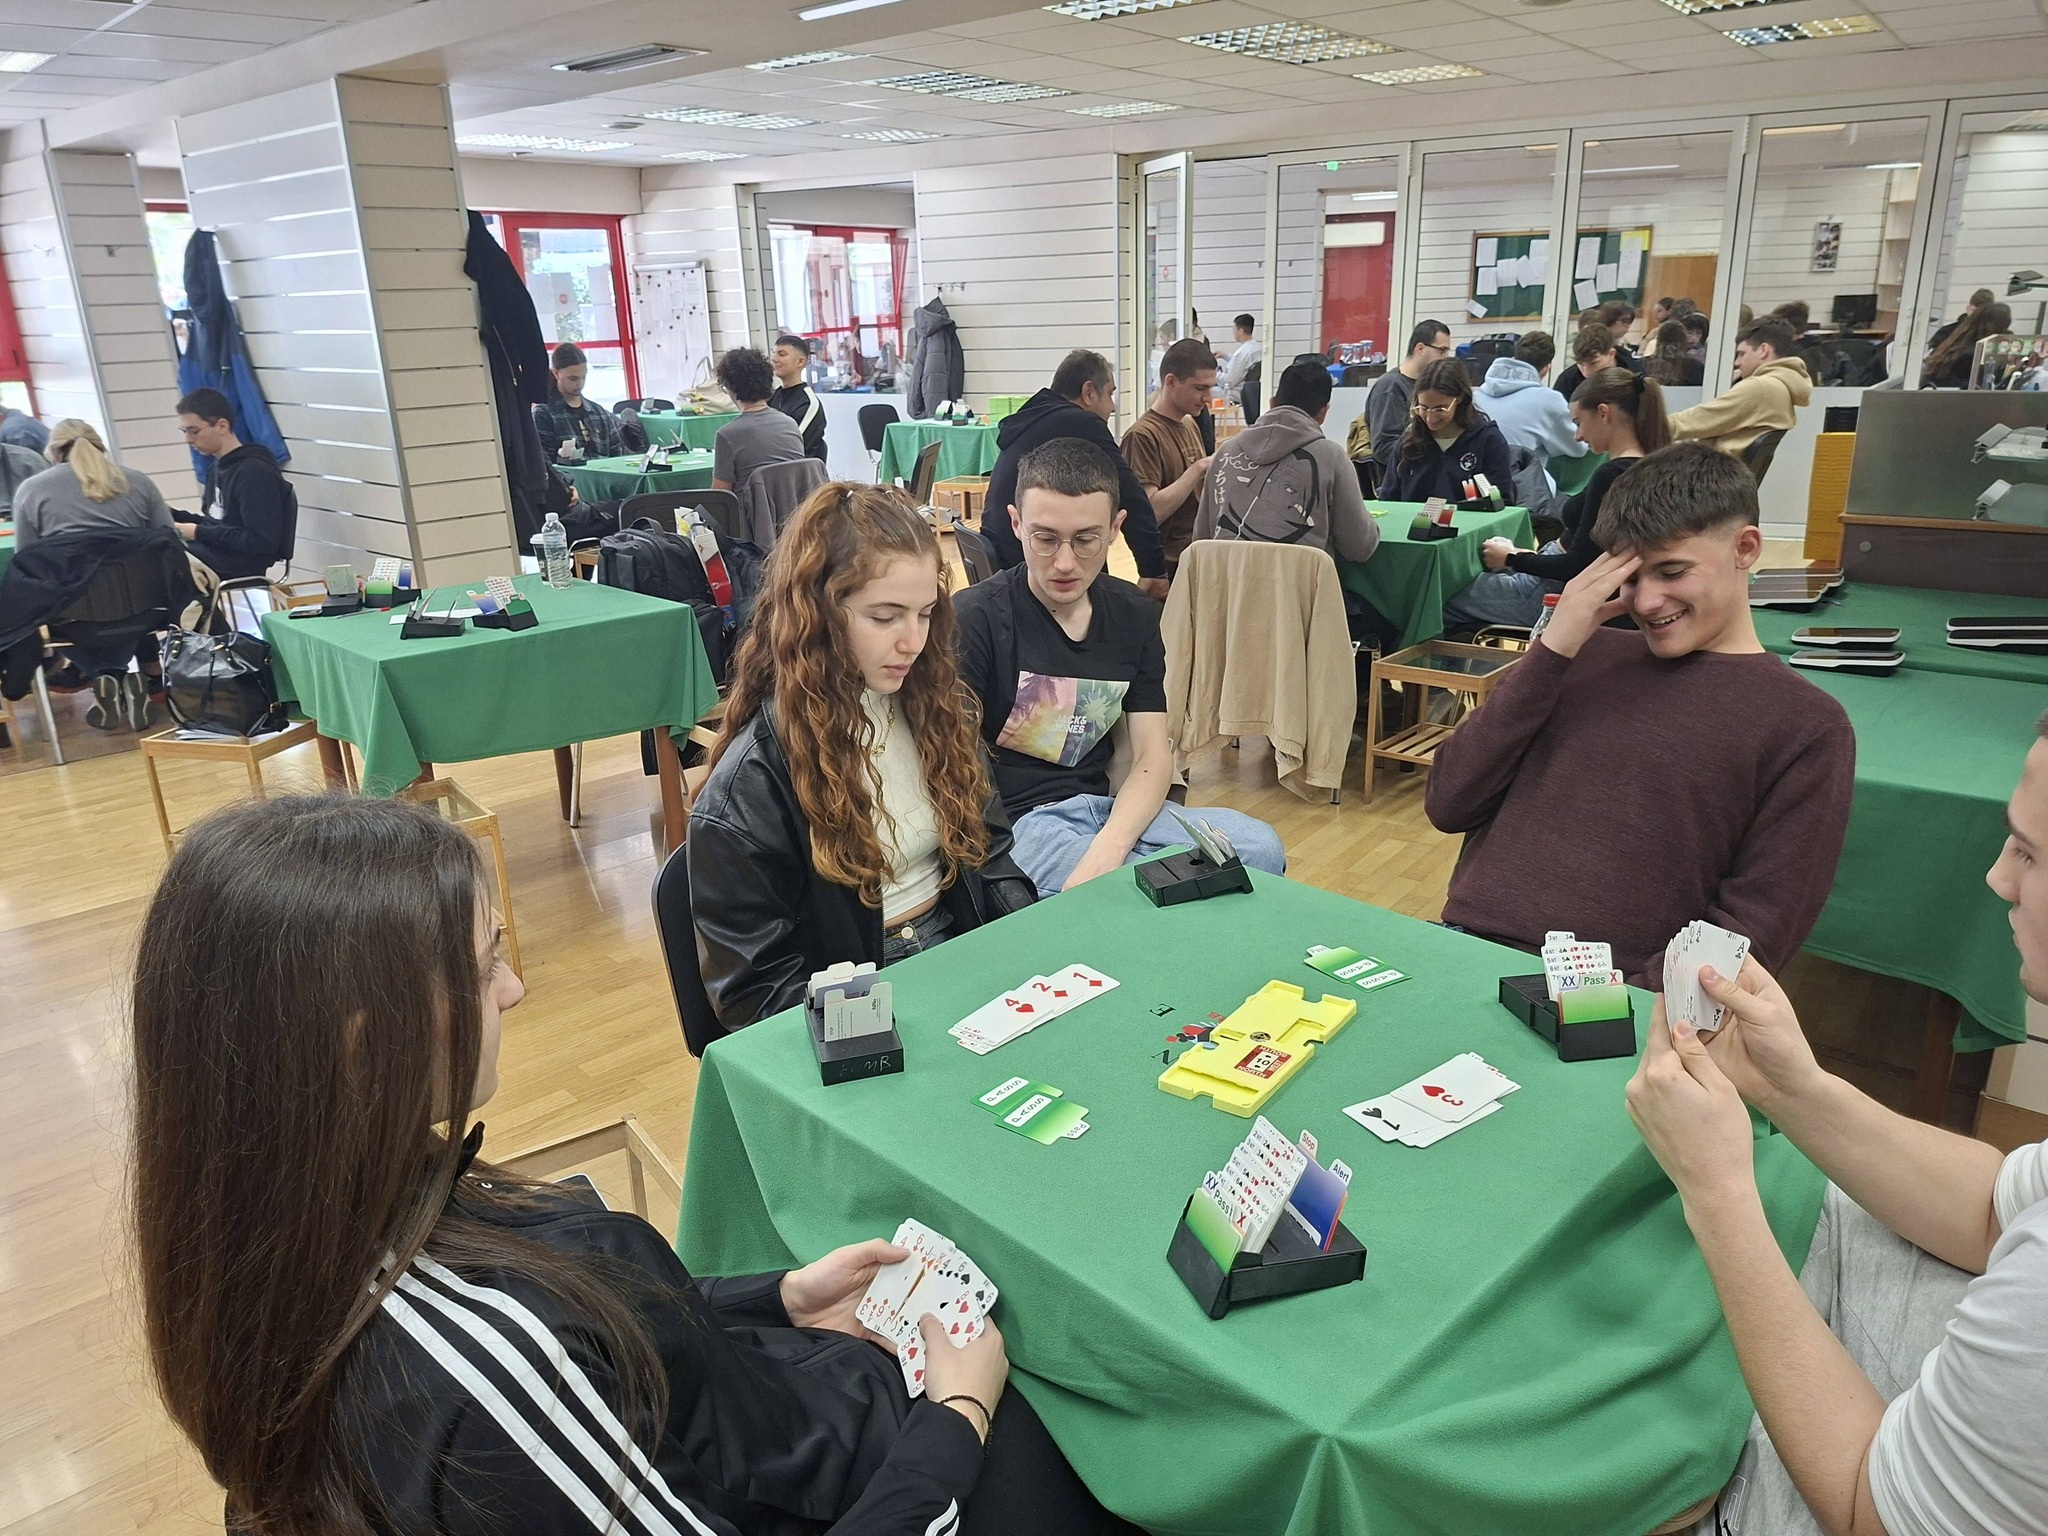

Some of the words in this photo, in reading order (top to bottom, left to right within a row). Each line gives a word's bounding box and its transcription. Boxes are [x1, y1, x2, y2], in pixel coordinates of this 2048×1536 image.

[1052, 724, 1085, 734] JONES
[1737, 941, 1745, 953] A
[1073, 972, 1088, 980] 1
[1561, 976, 1576, 987] XX
[1584, 977, 1606, 986] Pass
[1610, 972, 1618, 983] X
[1032, 982, 1052, 993] 2
[1005, 998, 1020, 1007] 4
[1149, 1003, 1176, 1018] E
[1259, 1046, 1288, 1058] SOUTH
[1257, 1058, 1271, 1066] 10
[1238, 1066, 1267, 1078] NORTH
[987, 1079, 1022, 1103] PASS
[1441, 1095, 1464, 1107] 3
[1012, 1097, 1045, 1123] PASS
[1382, 1119, 1401, 1131] 1
[1302, 1132, 1316, 1150] Stop
[1332, 1163, 1350, 1183] Alert
[1205, 1175, 1219, 1191] XX
[1213, 1191, 1230, 1215] Pass
[1236, 1212, 1247, 1228] X
[916, 1233, 925, 1245] 6
[958, 1261, 967, 1272] 6
[961, 1290, 970, 1300] 8
[859, 1304, 869, 1315] 3
[900, 1341, 910, 1351] 8
